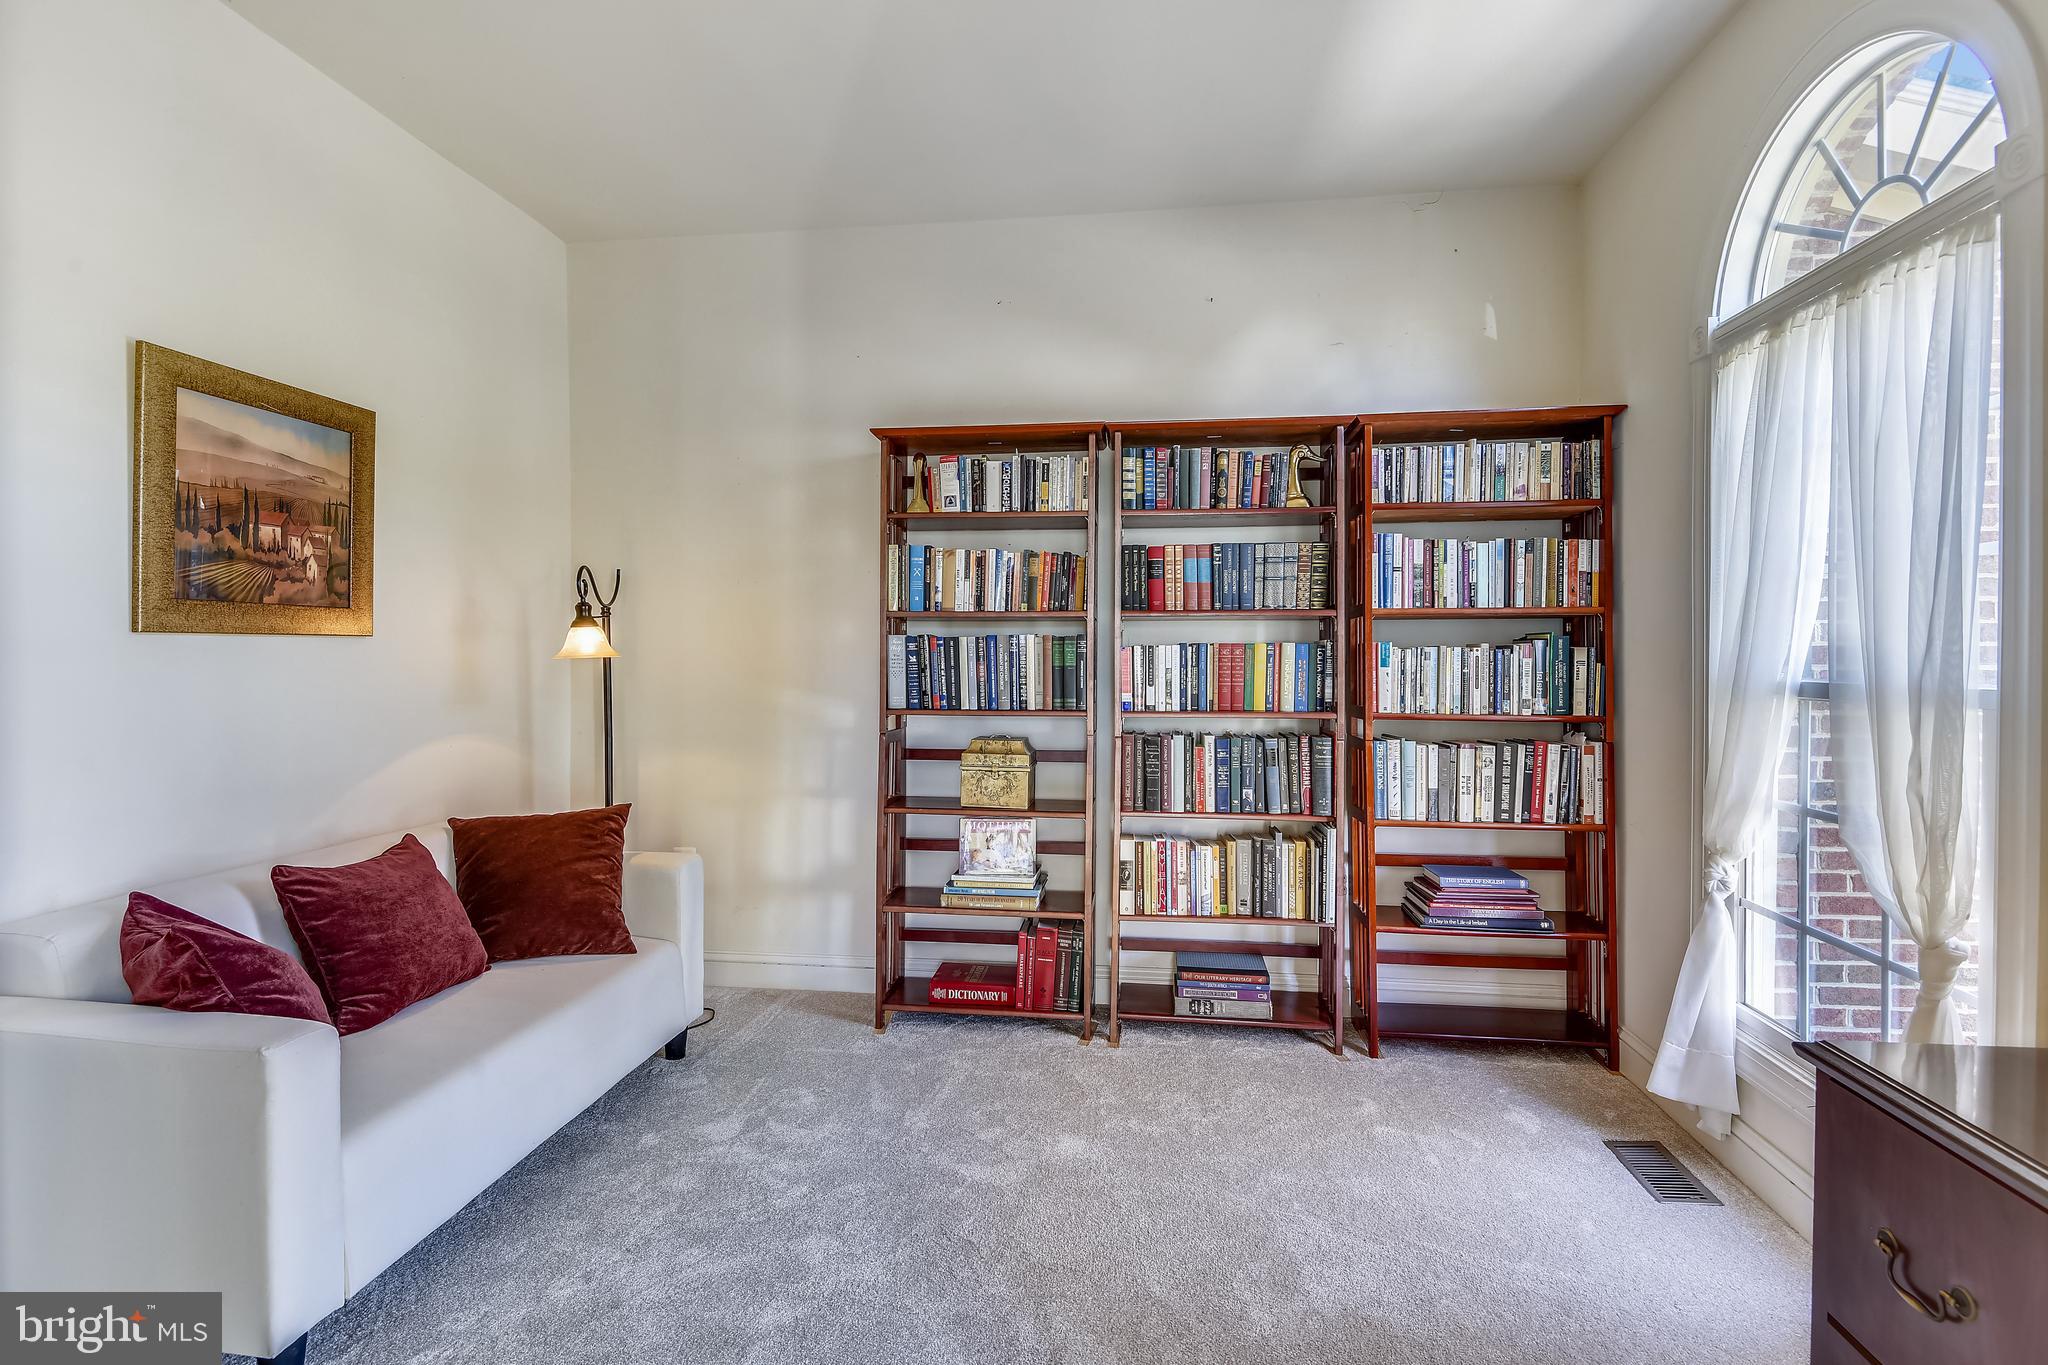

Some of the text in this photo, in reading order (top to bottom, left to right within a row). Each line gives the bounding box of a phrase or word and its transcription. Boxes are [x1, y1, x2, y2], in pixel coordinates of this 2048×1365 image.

[1316, 648, 1325, 672] LOLITA
[1301, 736, 1311, 788] NONCOMPLIANT
[948, 989, 1000, 1002] DICTIONARY
